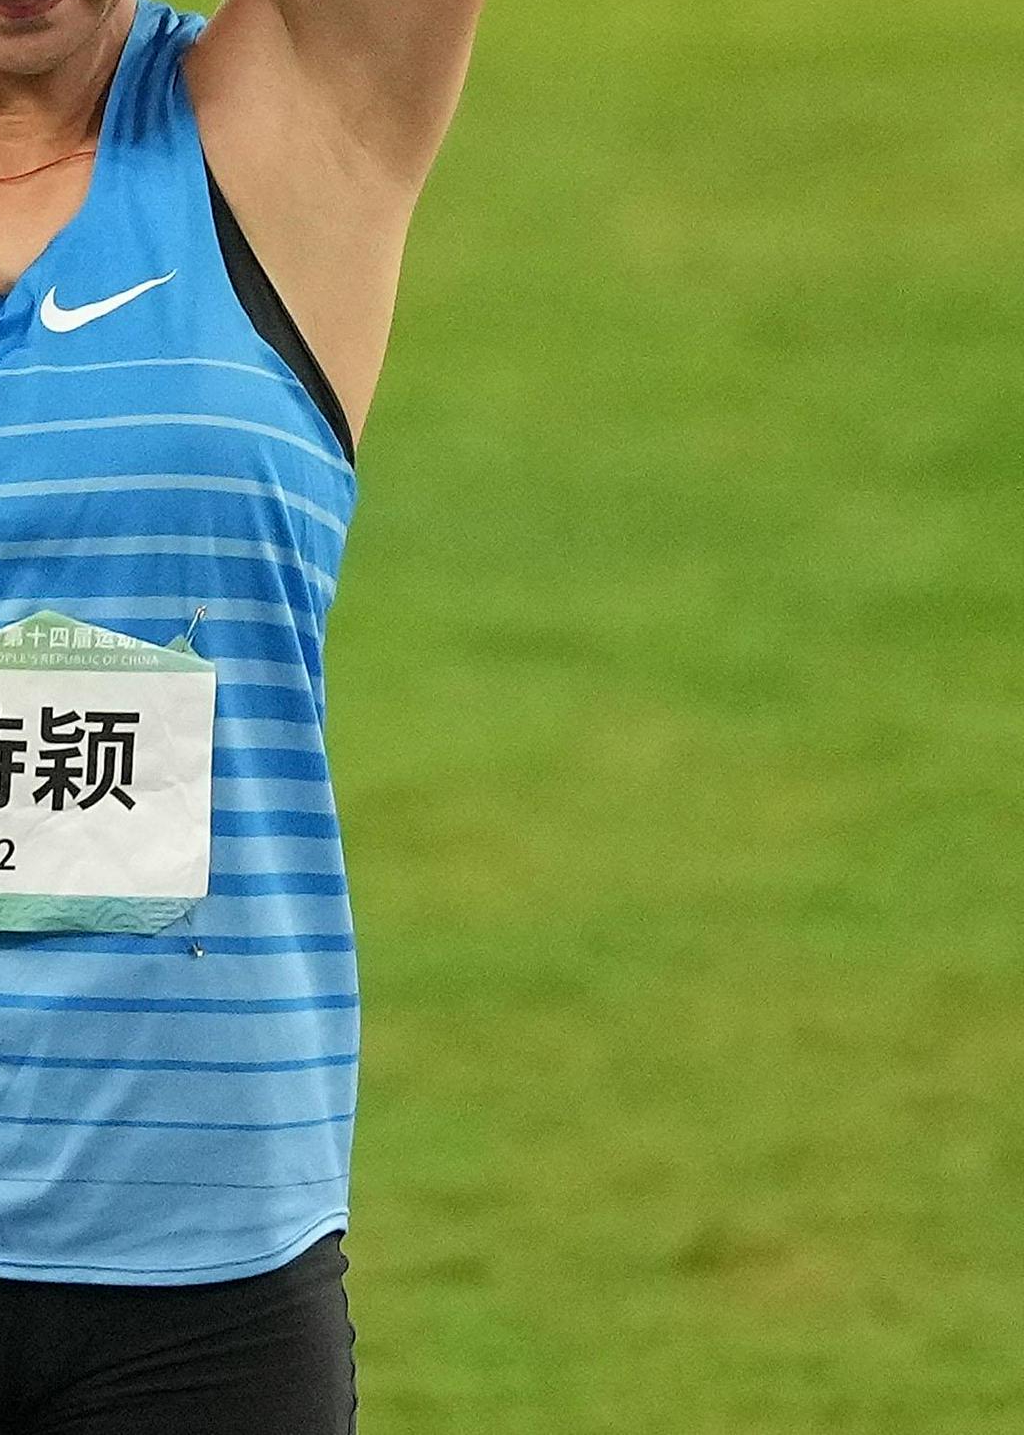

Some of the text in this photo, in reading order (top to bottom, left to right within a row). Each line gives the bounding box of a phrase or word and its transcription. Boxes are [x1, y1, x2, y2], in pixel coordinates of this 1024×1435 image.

[41, 652, 98, 665] REPUBLIC
[102, 654, 117, 666] OF
[121, 654, 159, 666] CHINA
